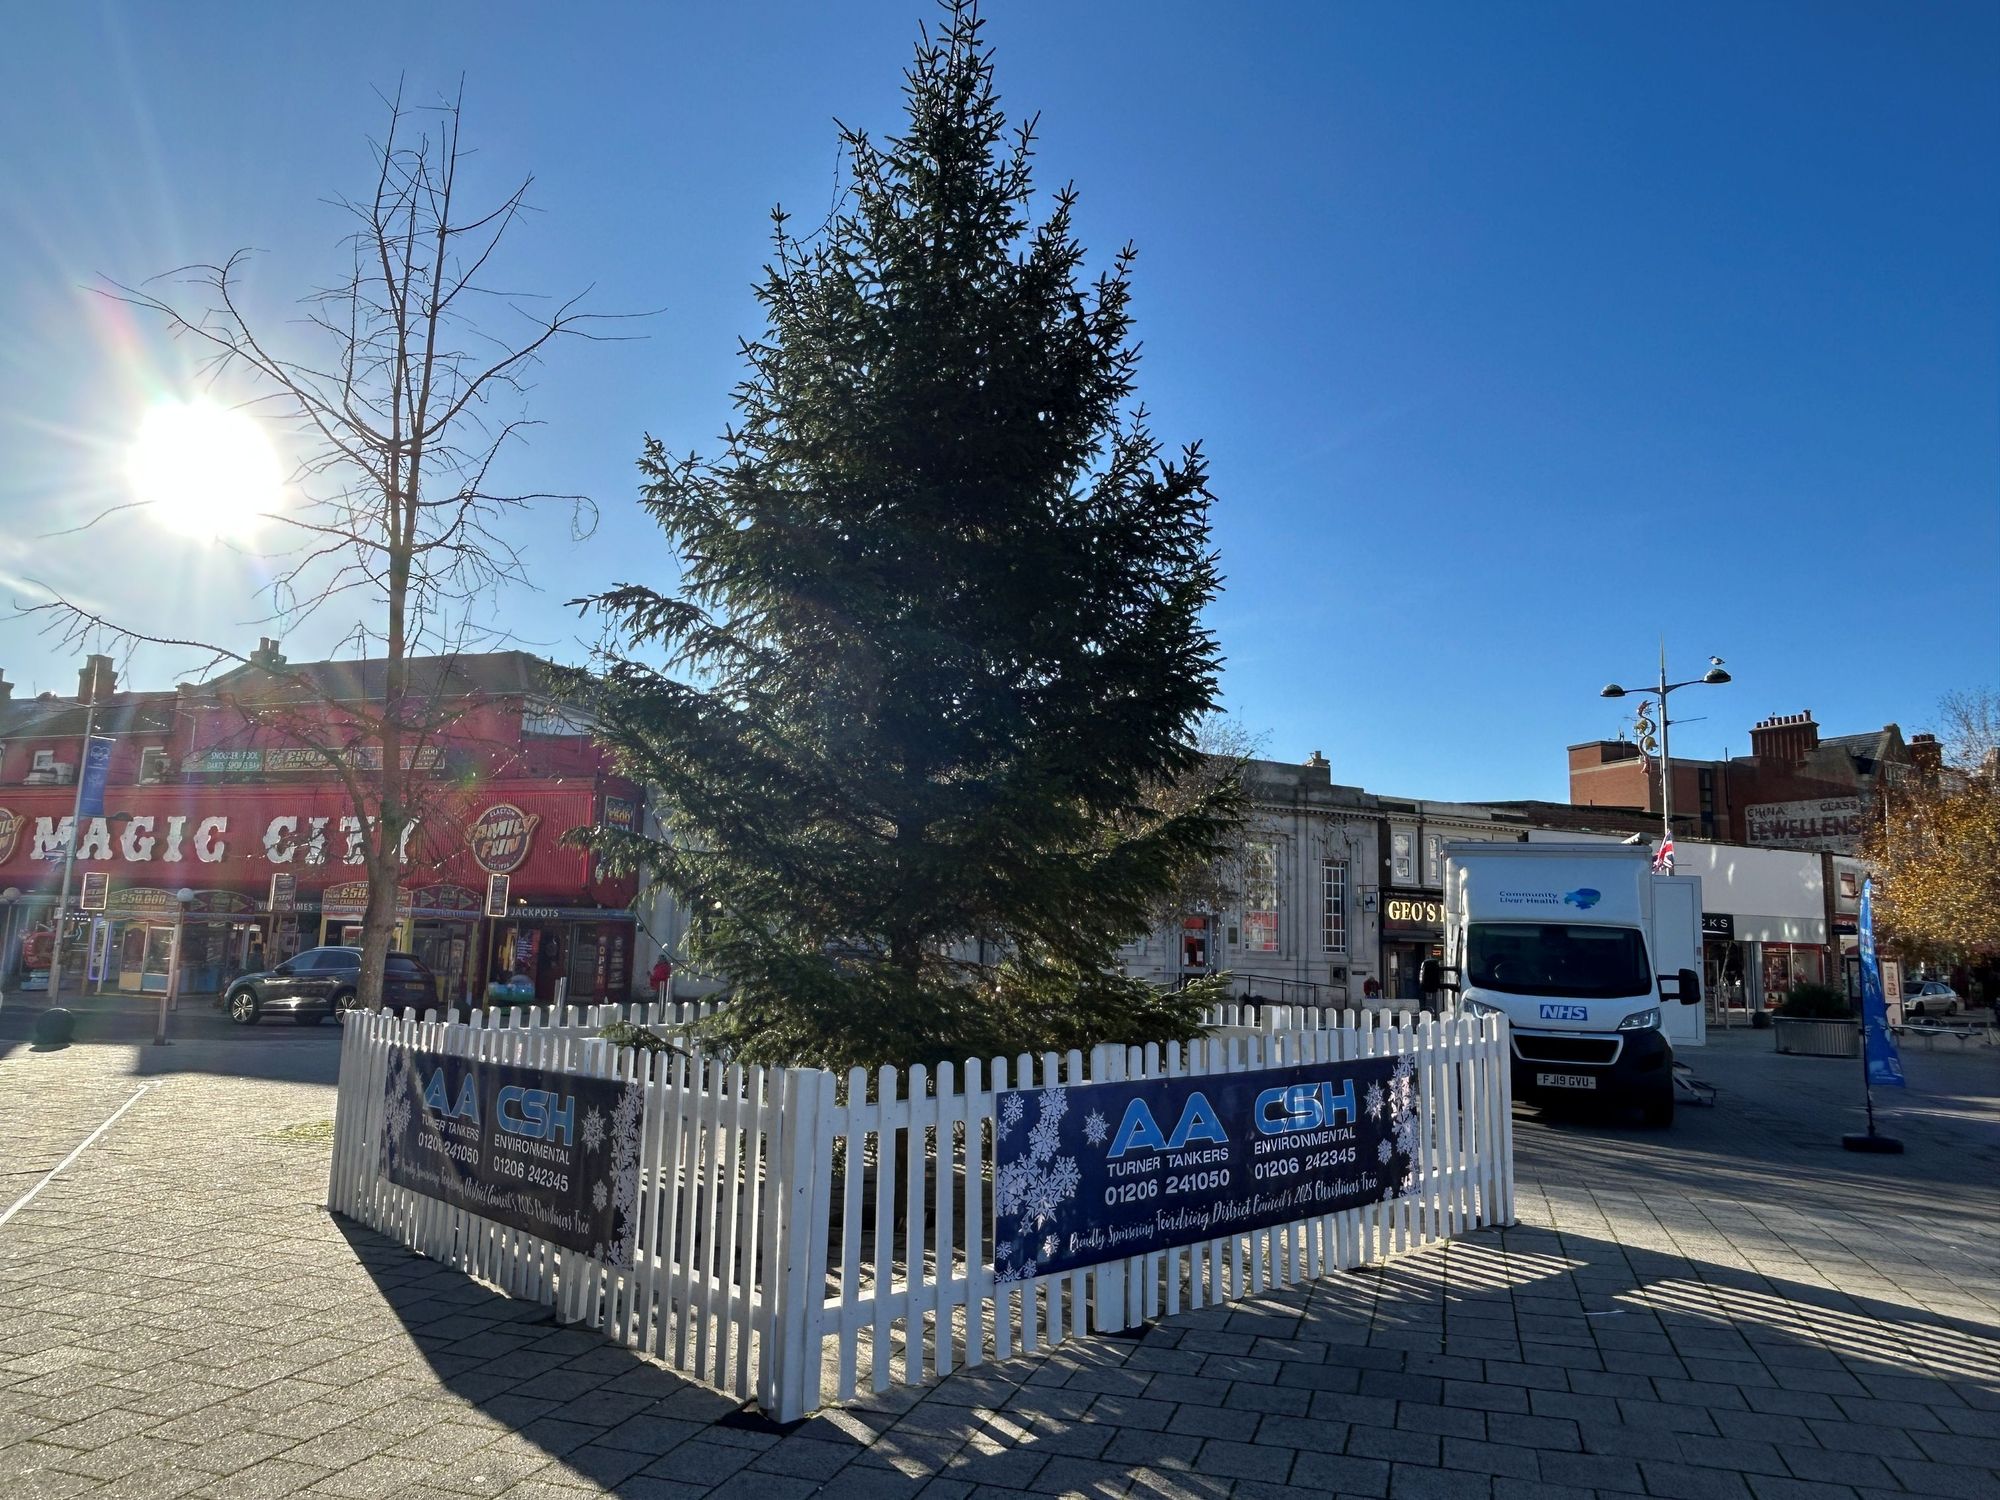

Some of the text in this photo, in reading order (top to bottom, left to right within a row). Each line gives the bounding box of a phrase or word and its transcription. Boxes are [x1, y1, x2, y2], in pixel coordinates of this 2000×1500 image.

[489, 808, 516, 818] CLACTON
[1747, 800, 1857, 818] CHINA GLASS
[30, 816, 228, 863] MAGIC
[465, 815, 540, 843] FAMILY
[481, 836, 522, 859] FUN
[1499, 890, 1558, 899] Community
[510, 908, 559, 918] JACKPOTS
[1388, 901, 1436, 922] GEO'S
[1541, 1005, 1586, 1020] NHS
[1543, 1074, 1589, 1087] FJ19 GVU
[423, 1066, 480, 1125] AA
[1254, 1079, 1356, 1135] CSH
[496, 1085, 575, 1147] CSH
[1106, 1091, 1230, 1159] AA
[448, 1120, 480, 1142] TANKERS
[1254, 1127, 1357, 1155] ENVIRONMENTAL
[444, 1140, 479, 1165] 241050
[494, 1133, 571, 1166] ENVIRONMENTAL
[1106, 1148, 1229, 1177] TURNER TANKERS
[1254, 1147, 1356, 1180] 01206 242345
[493, 1156, 569, 1193] 01206 242345
[1104, 1168, 1230, 1206] 01206 241050
[1069, 1171, 1378, 1253] Proudly Sponsoring Tendring District Council's 2025 Christmas Tree
